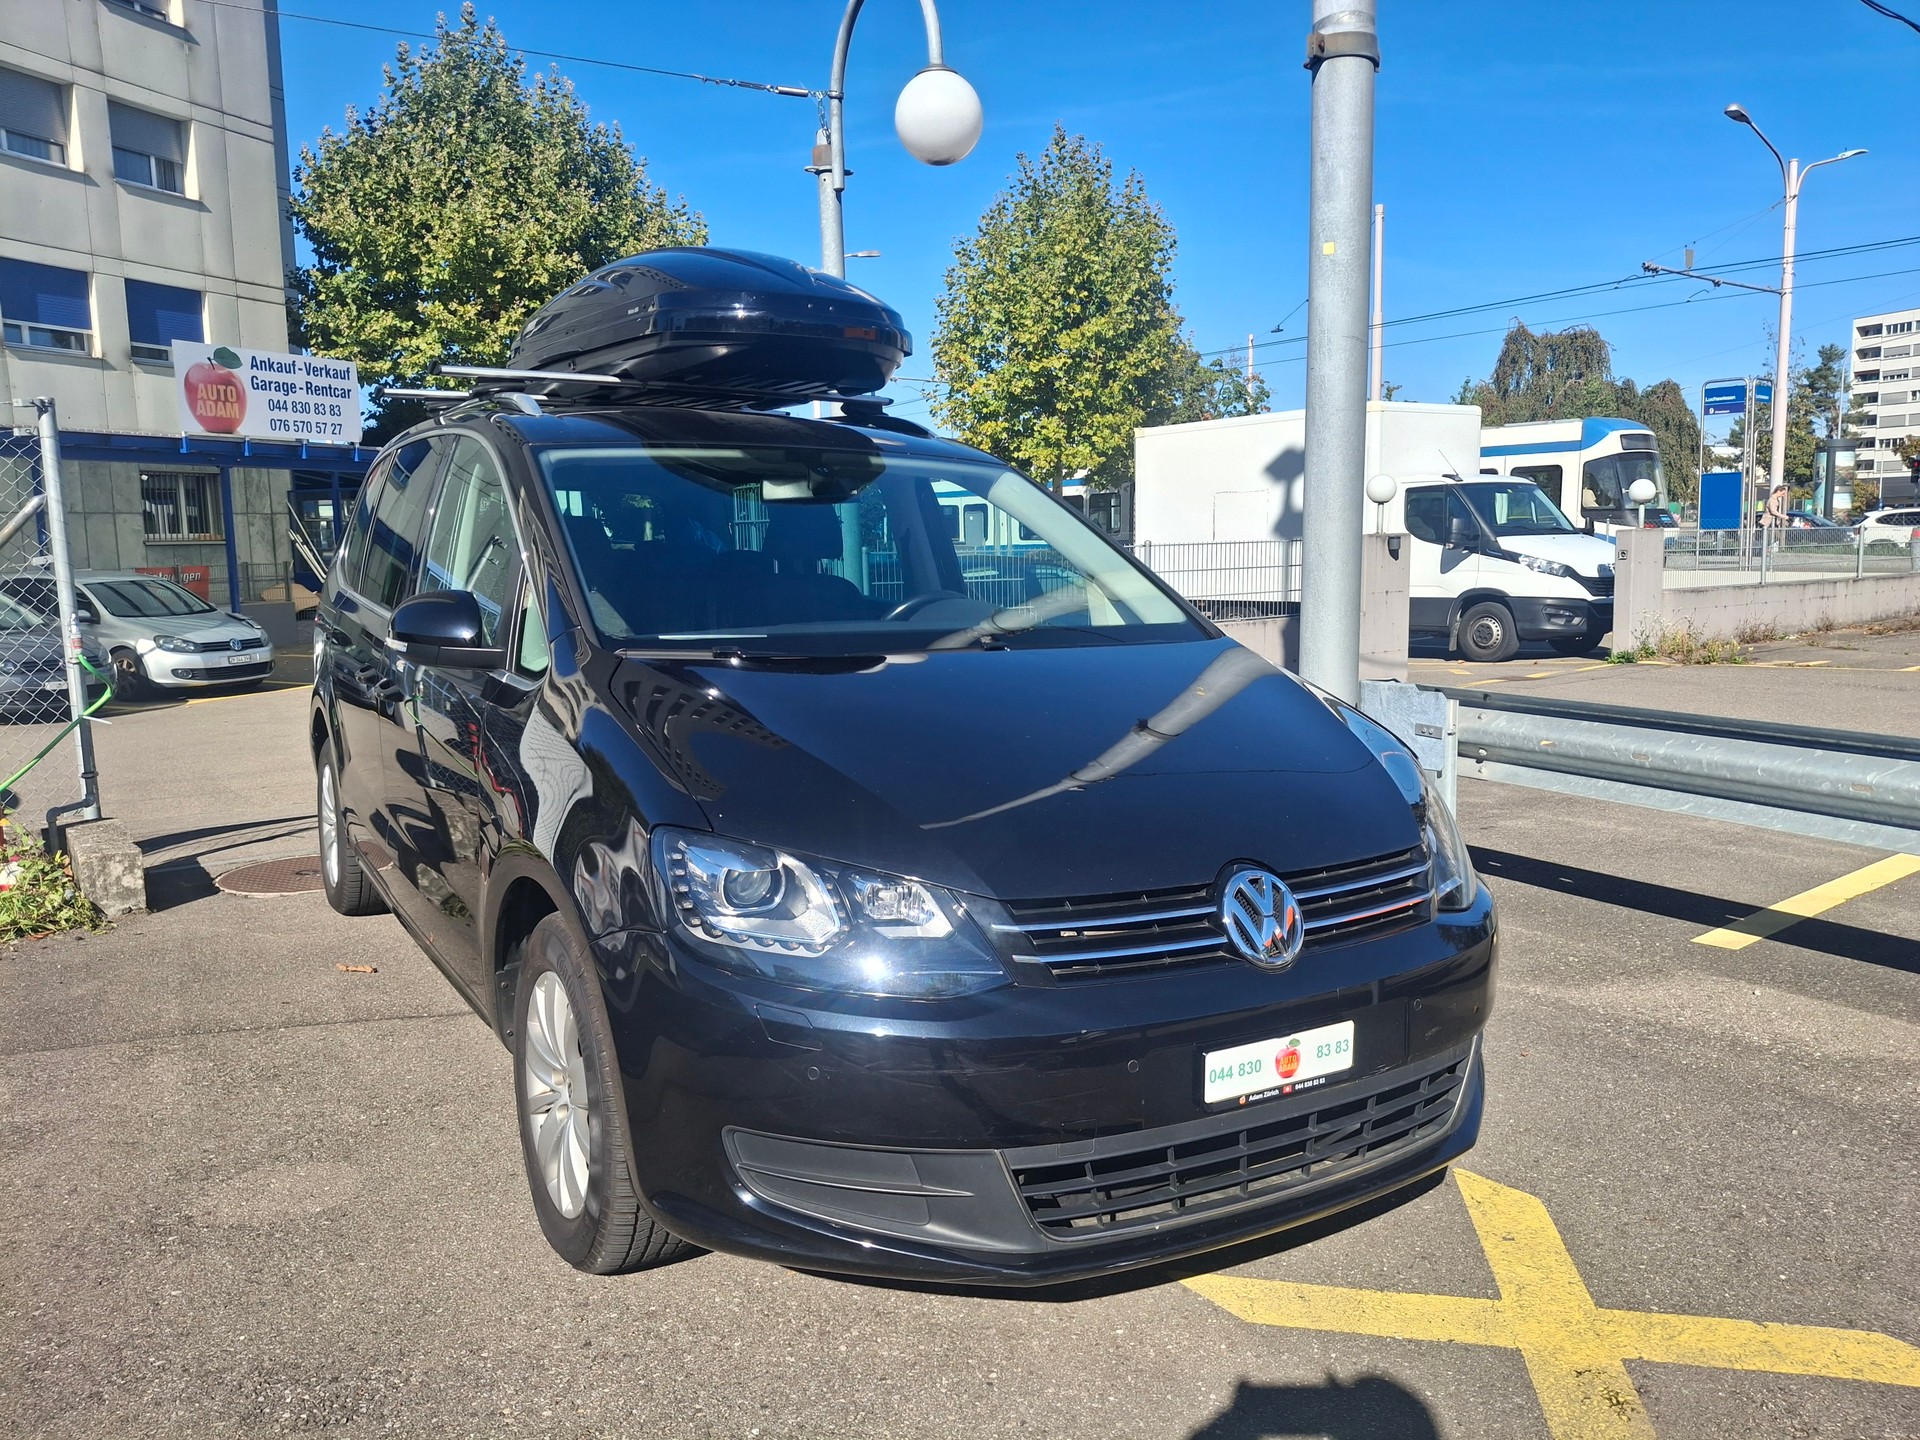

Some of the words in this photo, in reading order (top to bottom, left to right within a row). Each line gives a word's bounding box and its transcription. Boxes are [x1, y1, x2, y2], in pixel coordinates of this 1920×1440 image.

[197, 382, 237, 403] AUTO
[196, 400, 240, 419] ADAM
[268, 398, 288, 413] 044
[291, 400, 311, 414] 830
[313, 402, 327, 416] 83
[329, 404, 342, 417] 83
[270, 418, 290, 432] 076
[293, 420, 313, 434] 570
[315, 421, 328, 435] 57
[331, 423, 343, 436] 27
[1209, 1067, 1233, 1083] 044
[1238, 1059, 1262, 1077] 830
[1316, 1043, 1331, 1058] 83
[1335, 1039, 1349, 1054] 83
[1280, 1054, 1297, 1066] AUTO
[1248, 1093, 1263, 1102] Adam
[1263, 1088, 1280, 1098] Zürich
